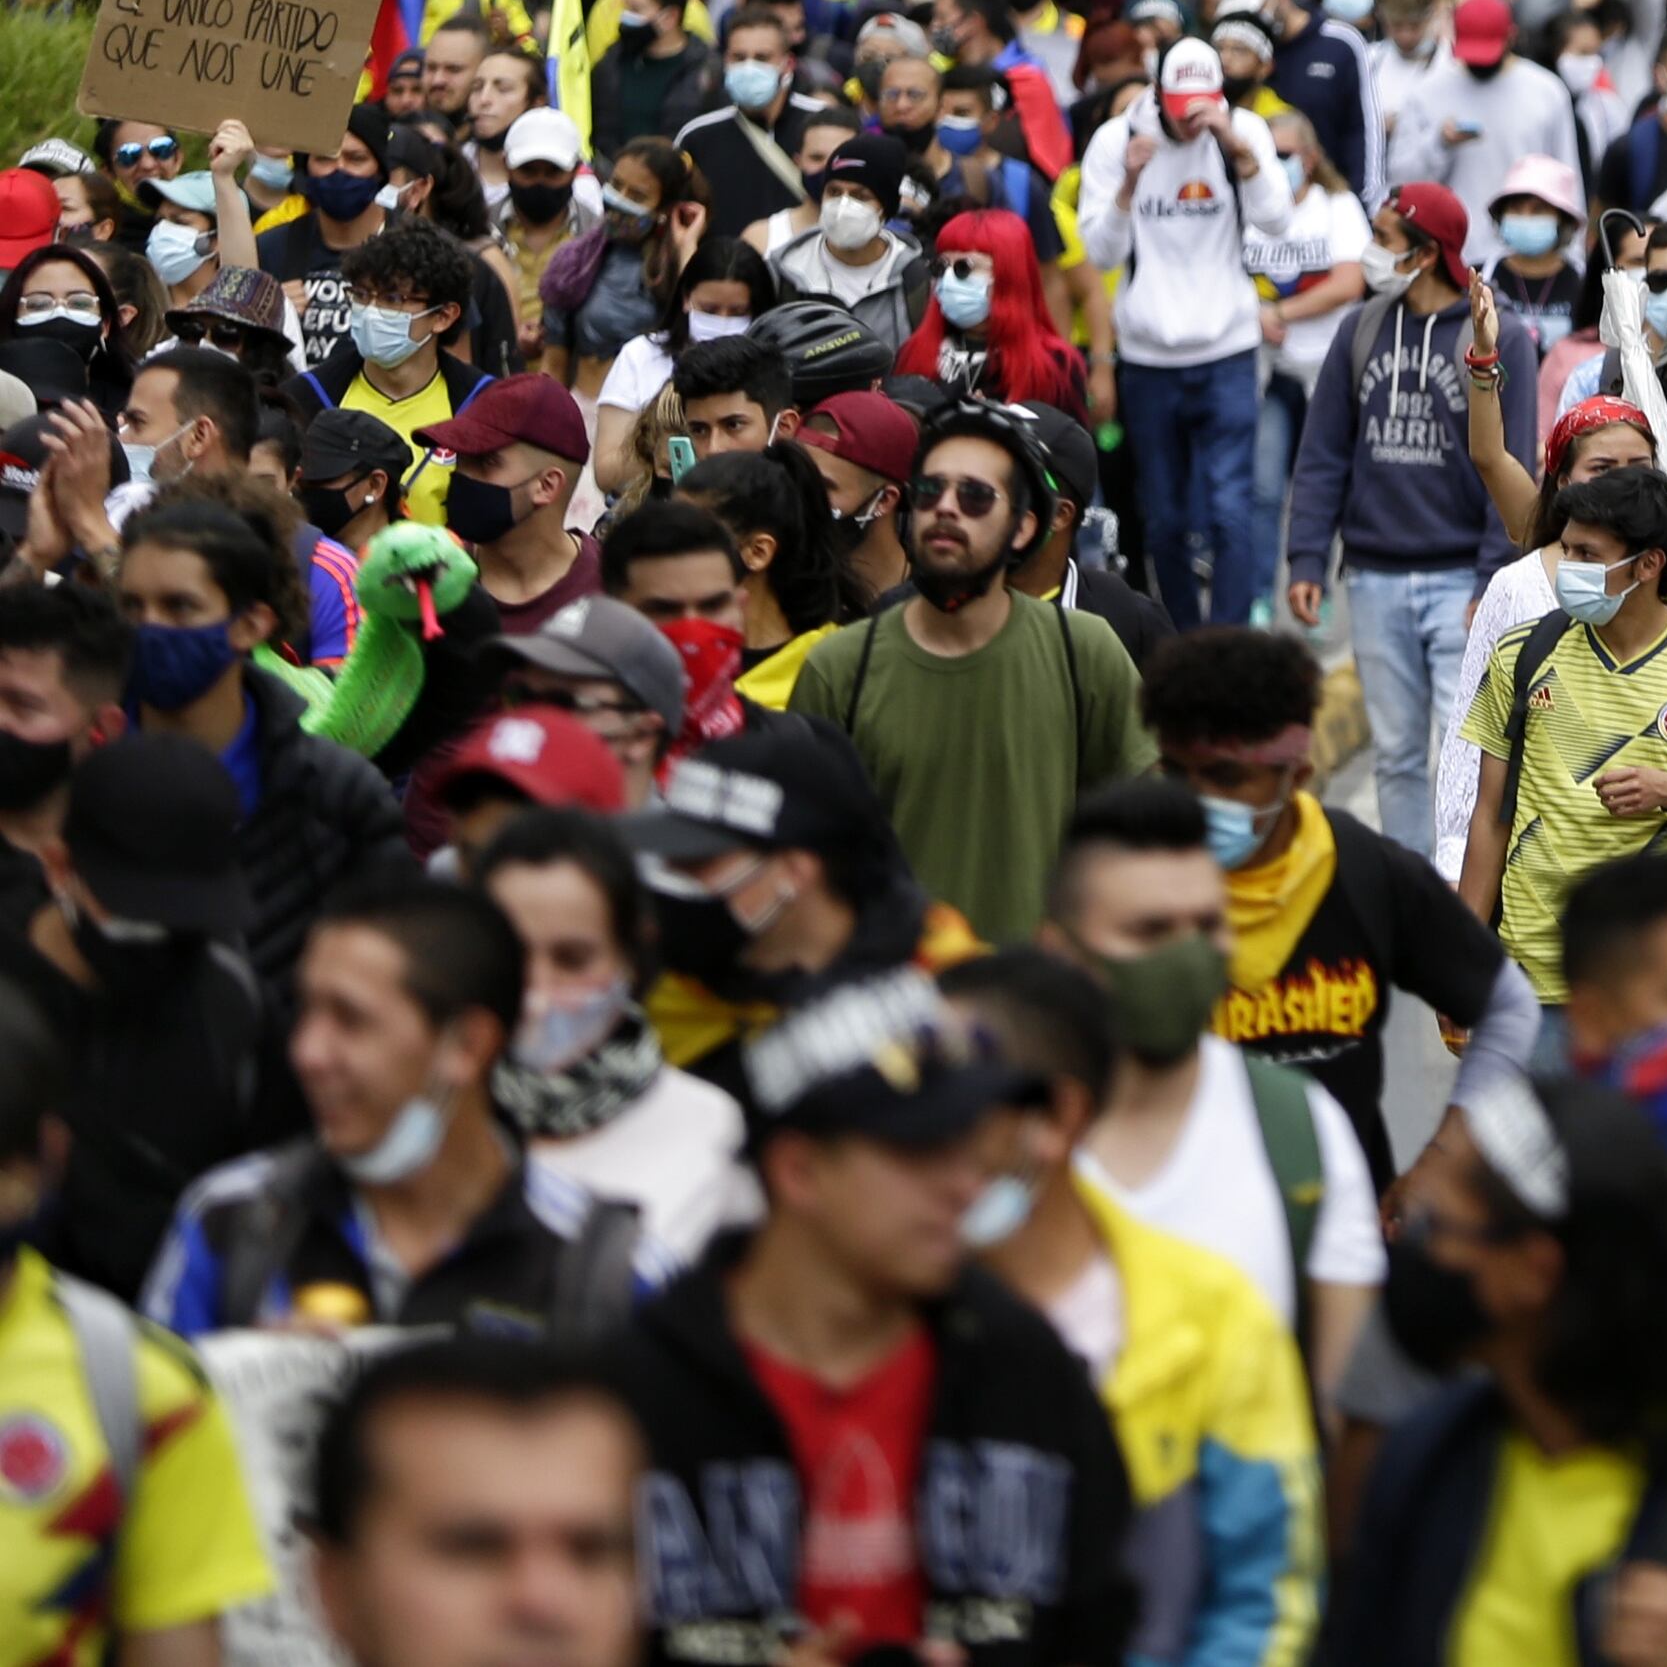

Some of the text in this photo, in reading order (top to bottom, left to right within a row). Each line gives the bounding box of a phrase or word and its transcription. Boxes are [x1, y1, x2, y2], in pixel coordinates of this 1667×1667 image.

[103, 23, 322, 97] QUE NOS UNE
[804, 331, 861, 359] ANSWER
[1365, 415, 1455, 450] ABRIL
